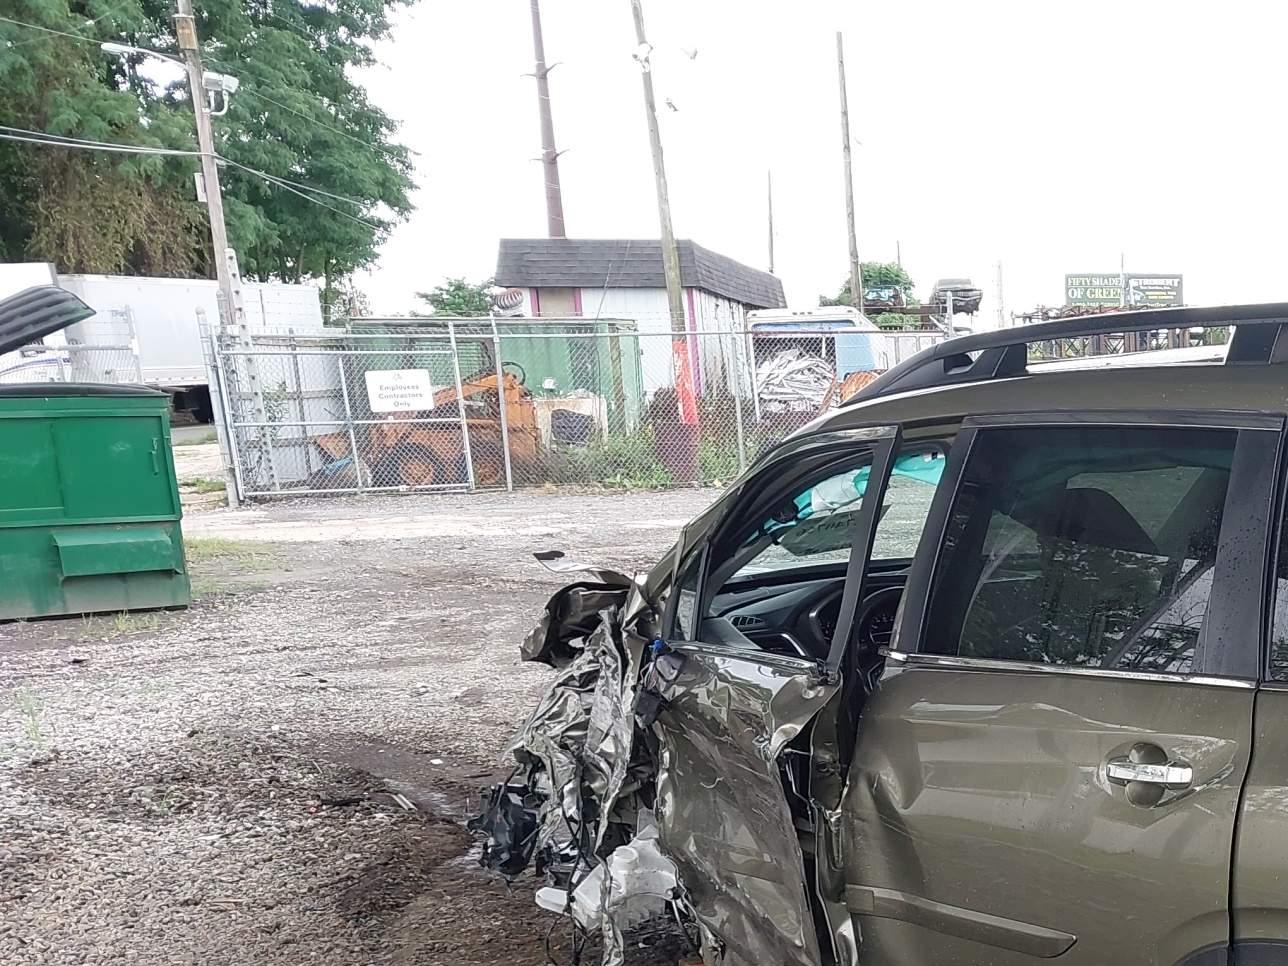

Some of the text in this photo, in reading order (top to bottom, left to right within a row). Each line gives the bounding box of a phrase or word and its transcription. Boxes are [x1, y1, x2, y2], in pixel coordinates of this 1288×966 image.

[1067, 277, 1091, 286] FIFTY
[1091, 277, 1122, 286] SHADE
[1067, 287, 1085, 299] OF
[379, 384, 420, 392] Employees
